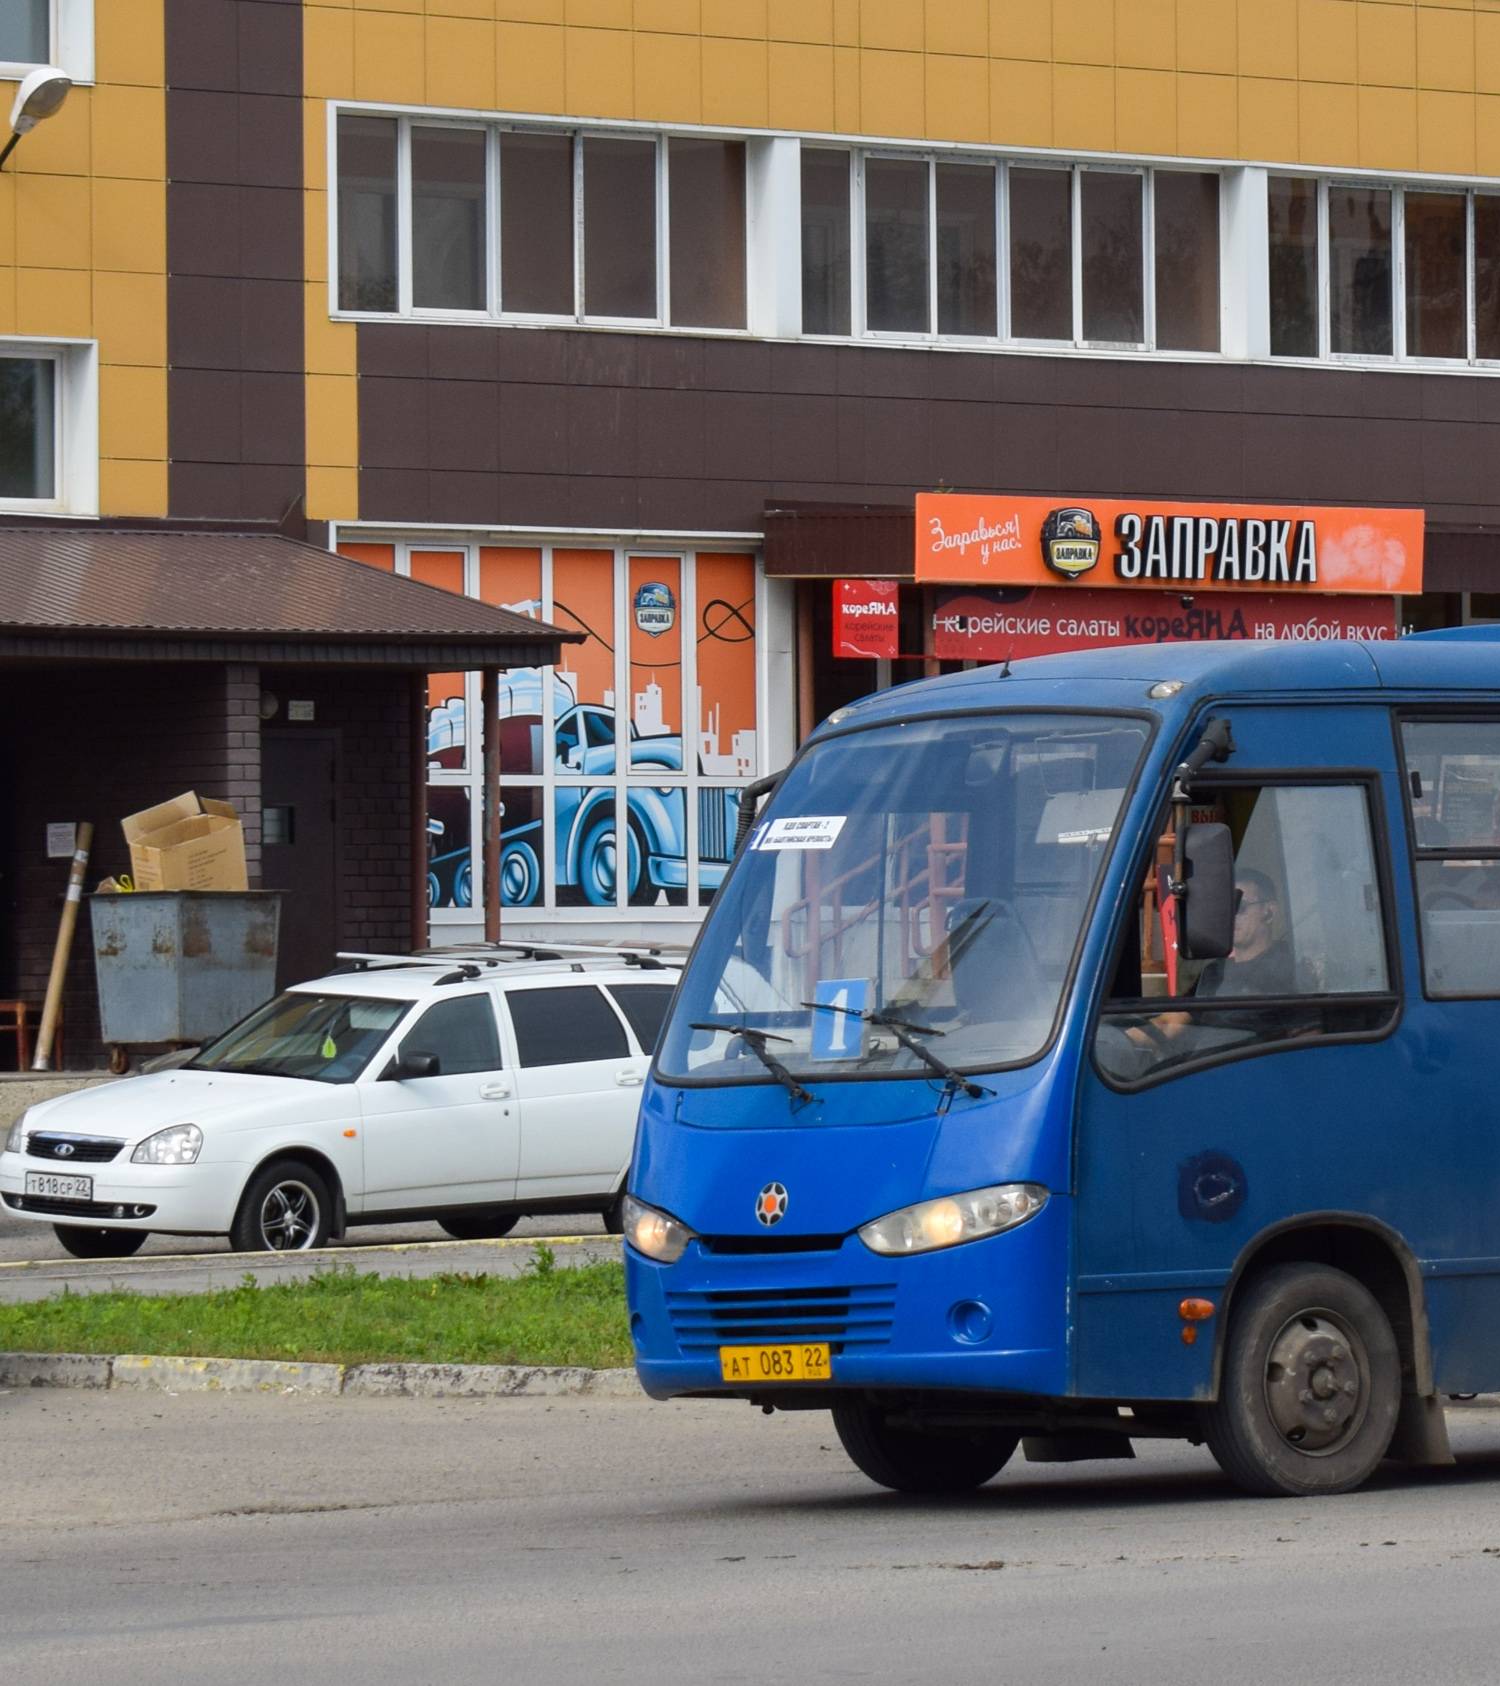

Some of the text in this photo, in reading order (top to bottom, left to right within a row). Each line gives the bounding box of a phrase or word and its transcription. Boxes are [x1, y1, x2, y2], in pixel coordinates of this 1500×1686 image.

[980, 542, 989, 565] у
[1055, 546, 1093, 561] ЗАПРАВКА
[1114, 513, 1317, 583] ЗАПРАВКА
[1056, 617, 1120, 637] салаты
[1254, 621, 1276, 641] на
[1281, 617, 1341, 641] любой
[827, 988, 849, 1050] 1
[732, 1357, 751, 1377] АТ
[760, 1349, 794, 1375] 083
[804, 1346, 822, 1367] 22
